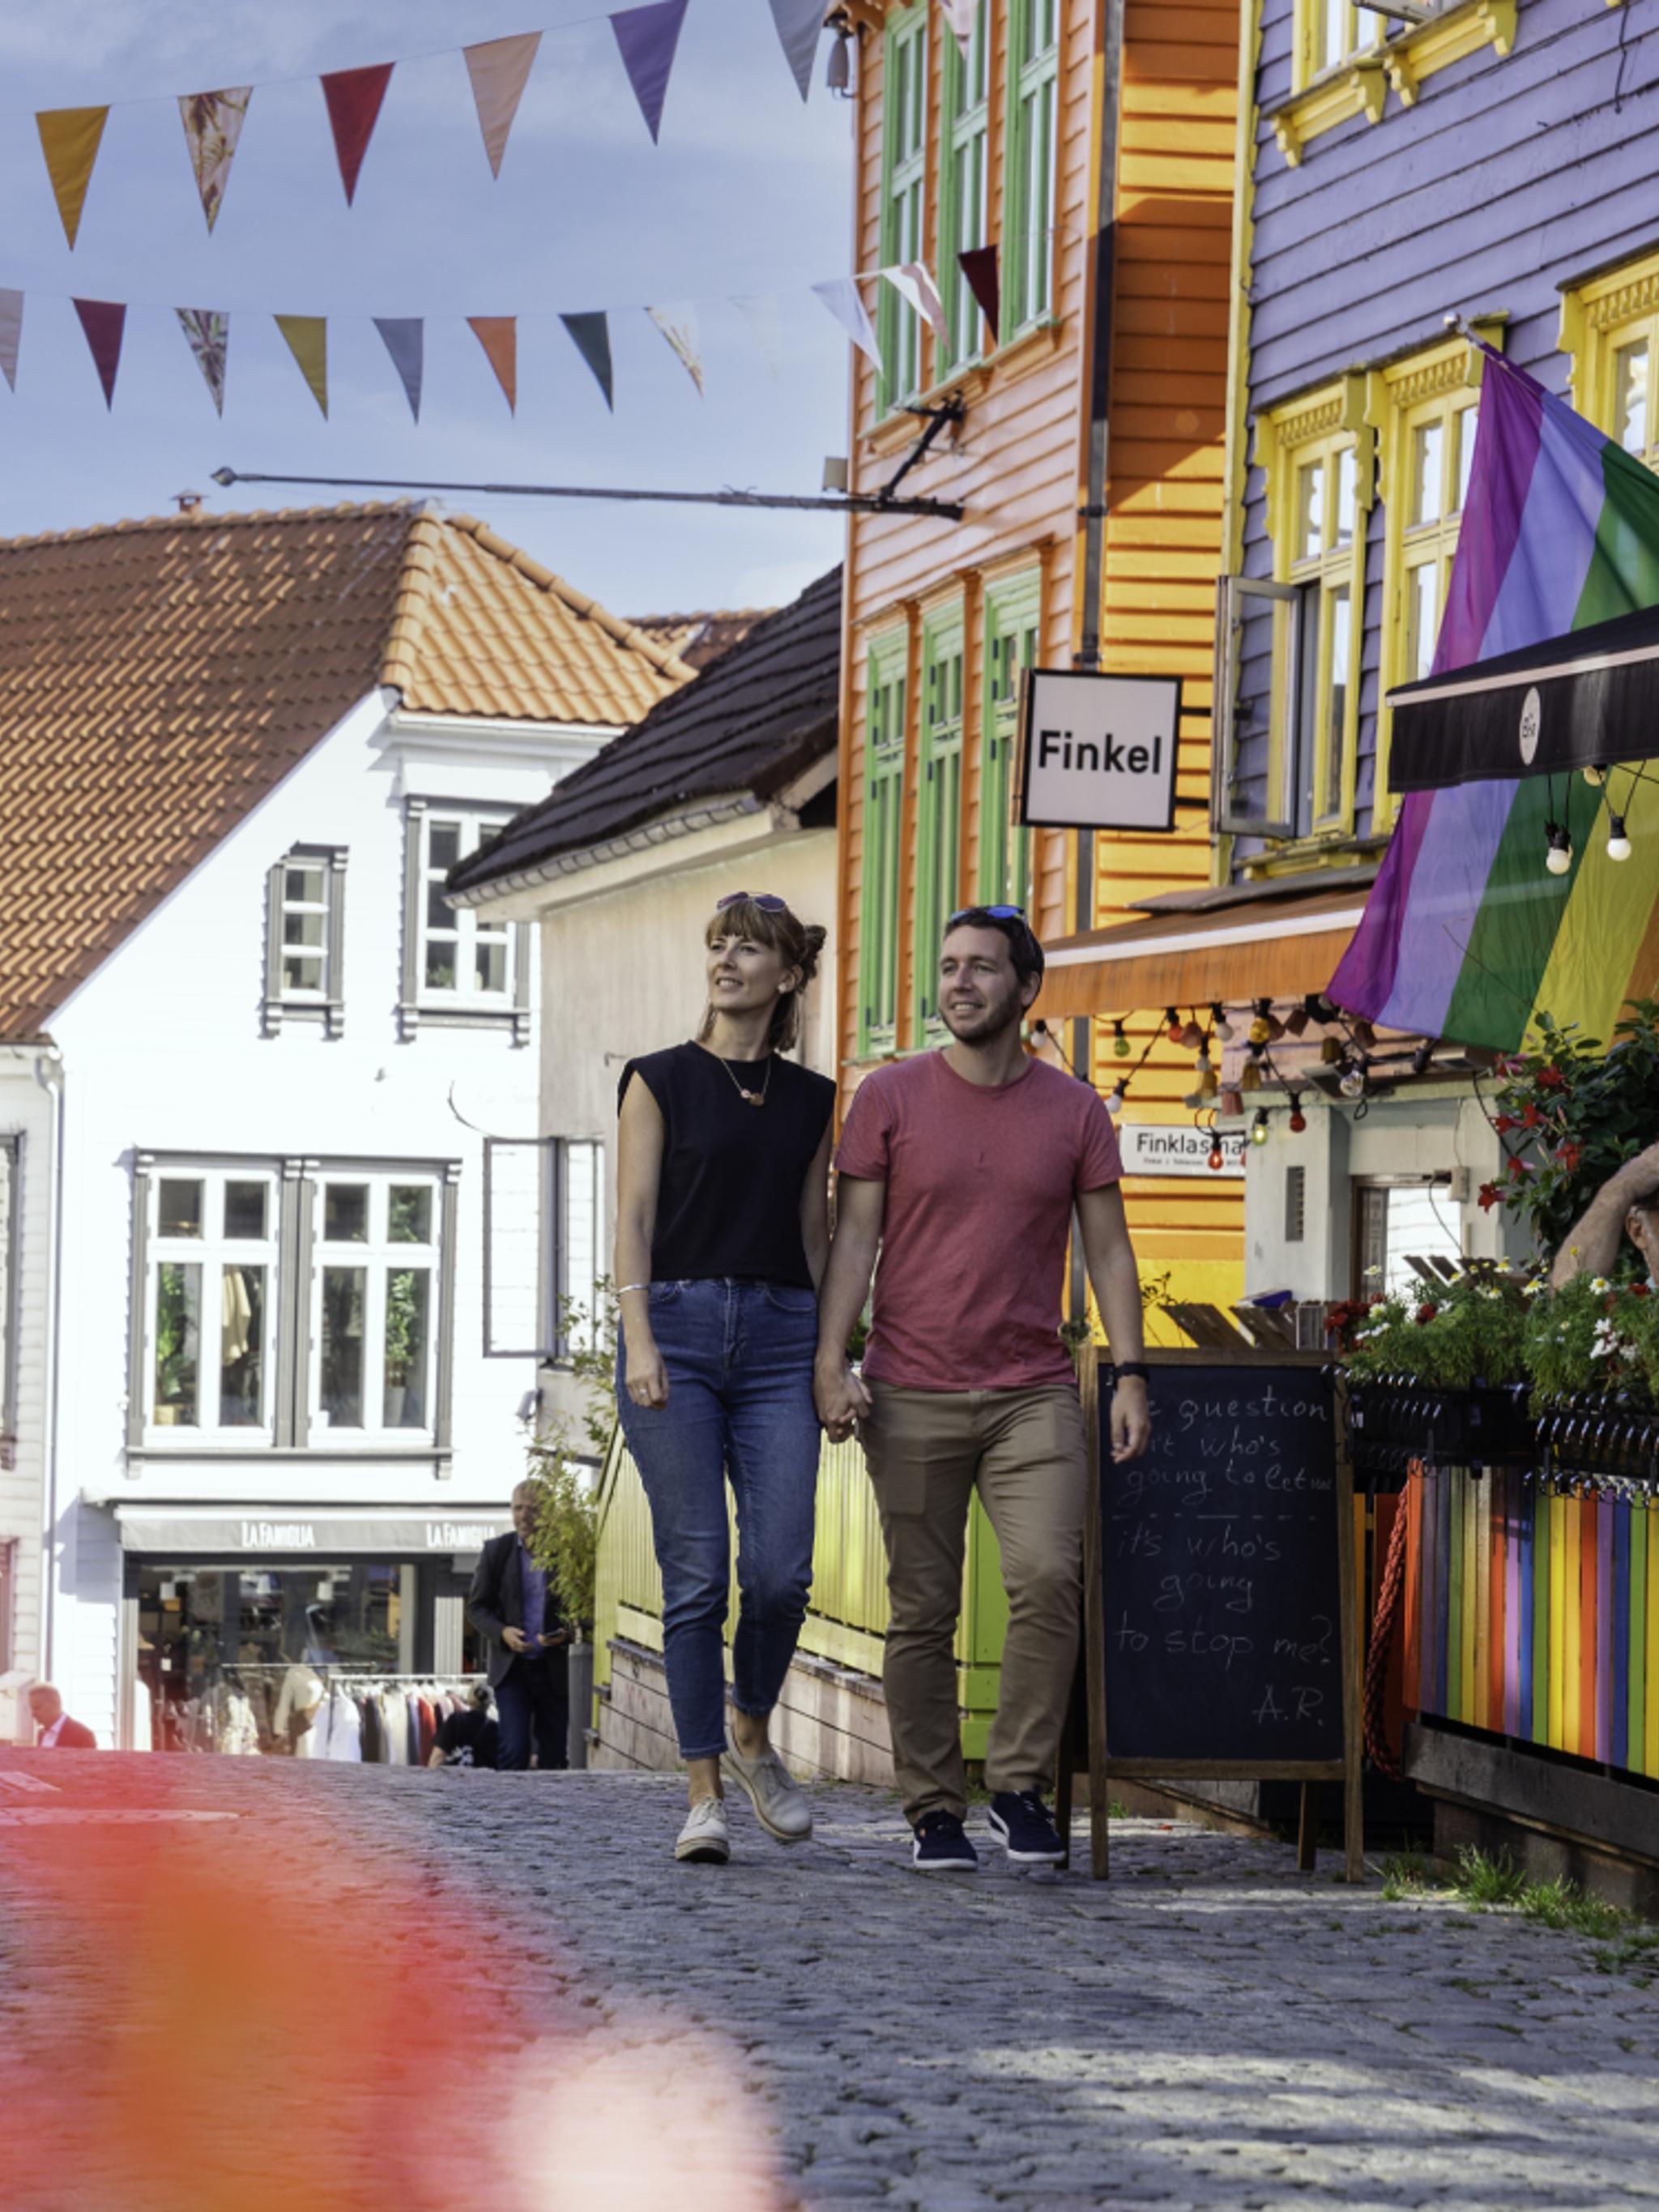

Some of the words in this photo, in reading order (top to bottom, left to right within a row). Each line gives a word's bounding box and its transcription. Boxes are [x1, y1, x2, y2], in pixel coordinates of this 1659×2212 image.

[1038, 729, 1162, 775] Finkel
[1179, 1384, 1328, 1433] question
[1200, 1424, 1282, 1458] who's
[1117, 1467, 1213, 1506] going
[1225, 1458, 1256, 1485] to
[1116, 1521, 1163, 1558] it's
[1187, 1522, 1282, 1561] who's
[1152, 1569, 1254, 1613] going
[1112, 1609, 1150, 1652] to
[1164, 1613, 1255, 1672] stop
[1273, 1613, 1333, 1666] me?
